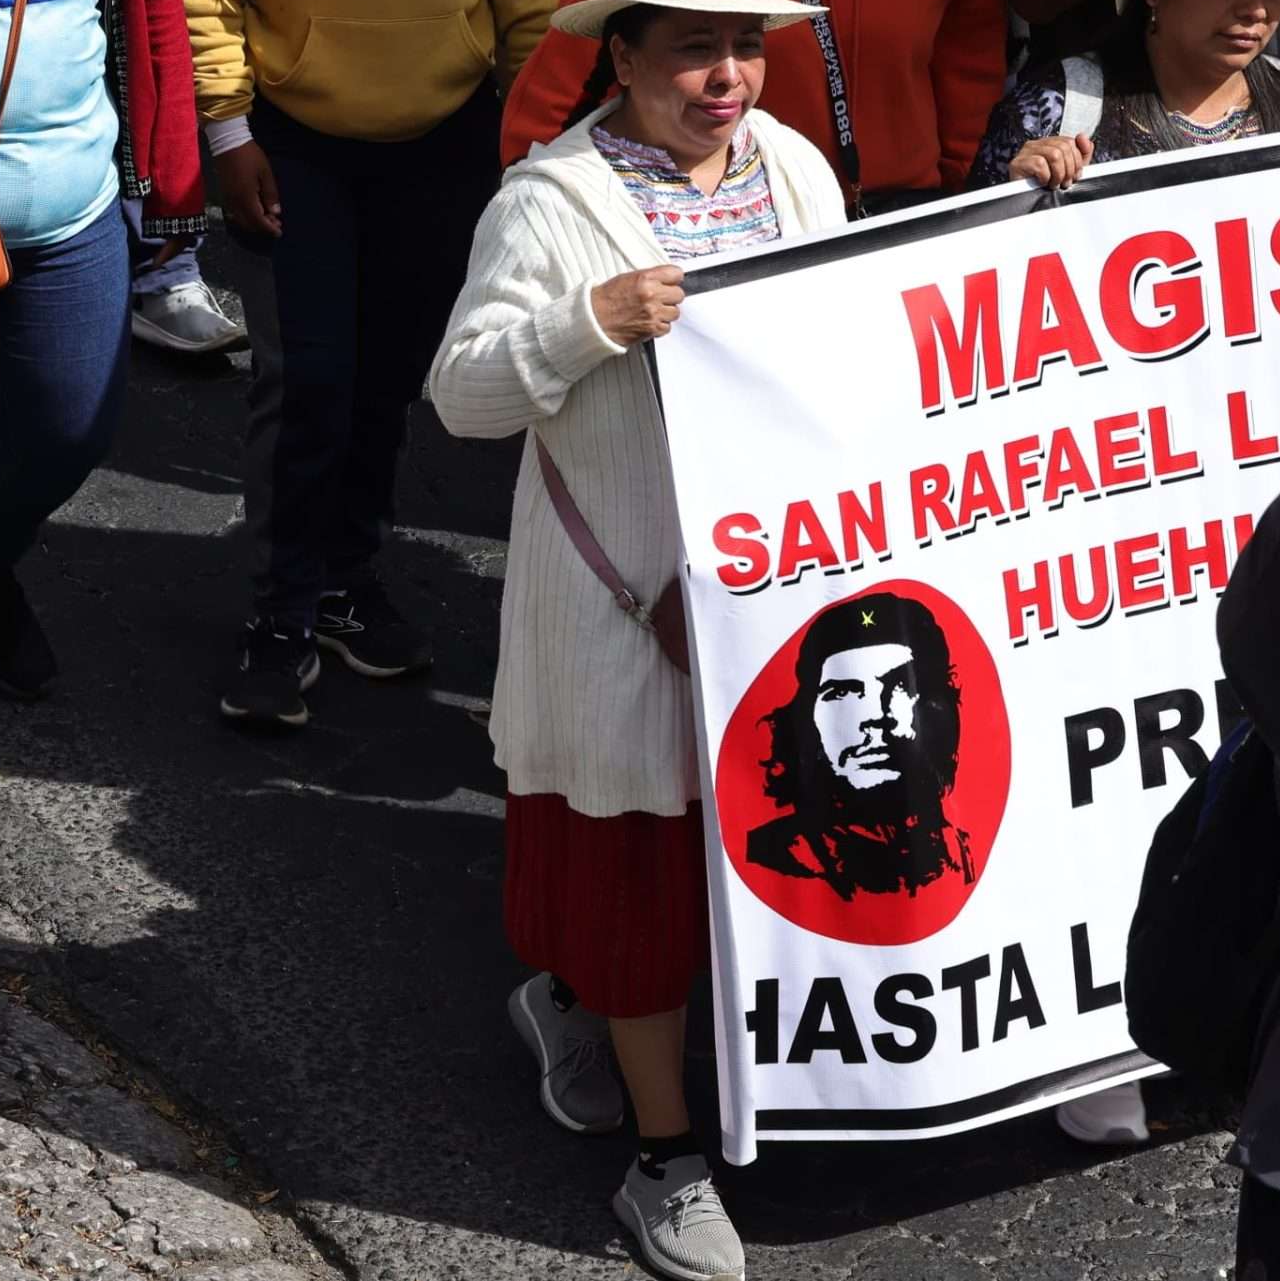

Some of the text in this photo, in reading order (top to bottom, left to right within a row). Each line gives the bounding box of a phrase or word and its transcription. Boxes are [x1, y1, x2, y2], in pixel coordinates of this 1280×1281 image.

[834, 99, 853, 147] 980
[712, 481, 892, 593] SAN
[910, 406, 1203, 546] RAFAEL
